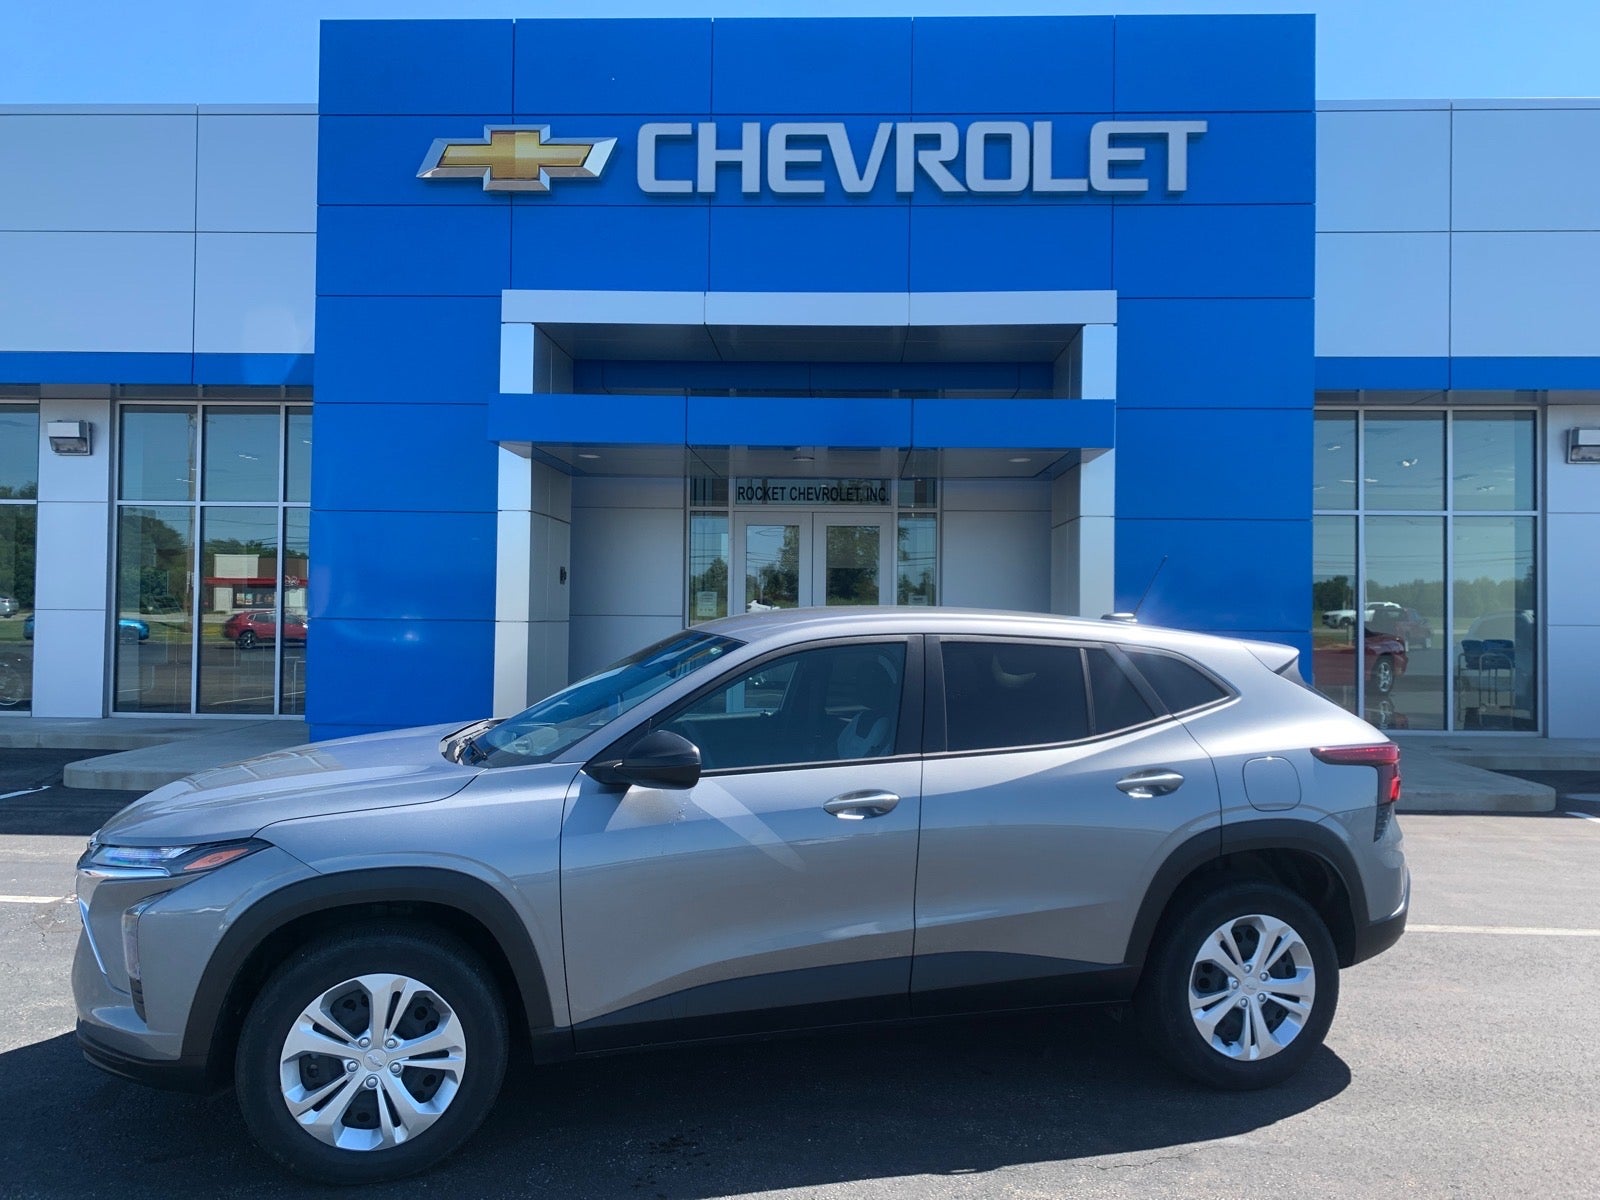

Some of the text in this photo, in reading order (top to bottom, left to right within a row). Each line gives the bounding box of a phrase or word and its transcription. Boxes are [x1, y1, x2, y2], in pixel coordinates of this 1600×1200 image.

[636, 119, 1208, 194] CHEVROLET
[737, 486, 787, 501] ROCKET
[866, 487, 889, 501] INC.
